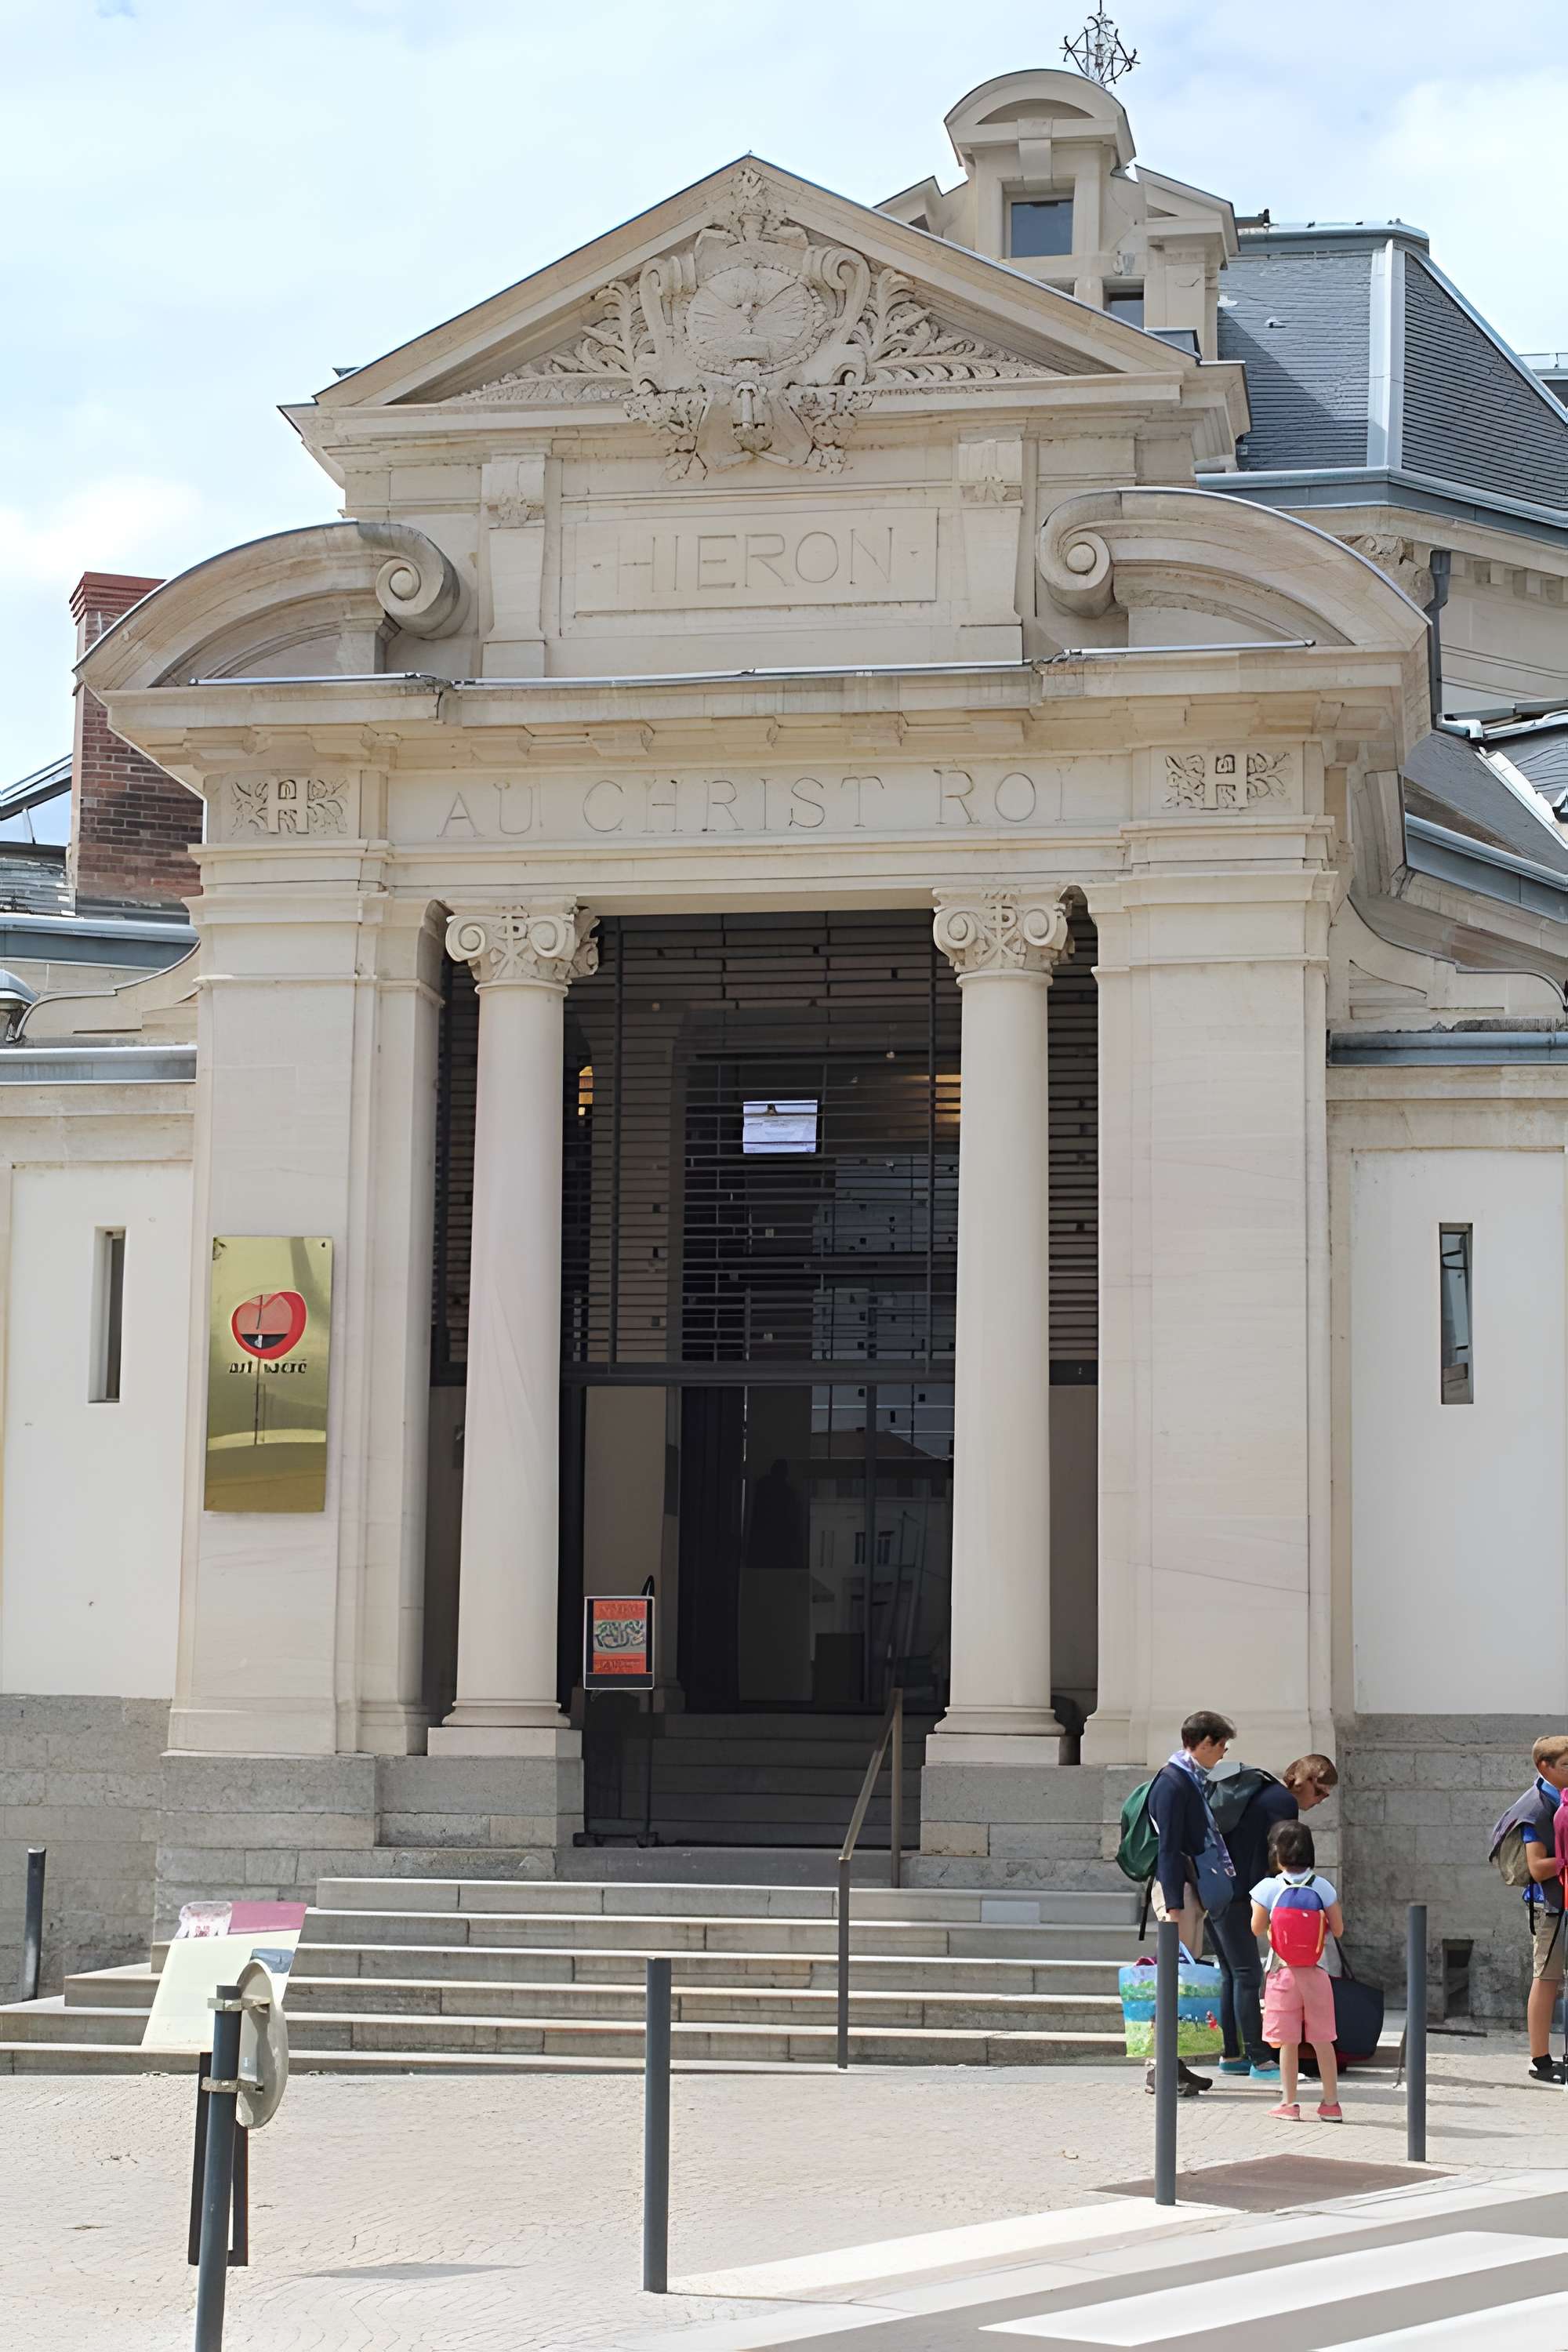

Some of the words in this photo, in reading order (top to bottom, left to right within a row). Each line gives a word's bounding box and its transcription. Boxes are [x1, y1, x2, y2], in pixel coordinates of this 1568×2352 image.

[616, 526, 895, 595] HIERON
[436, 782, 543, 837] AU
[582, 775, 885, 833] CHRIST
[933, 766, 1071, 825] ROI
